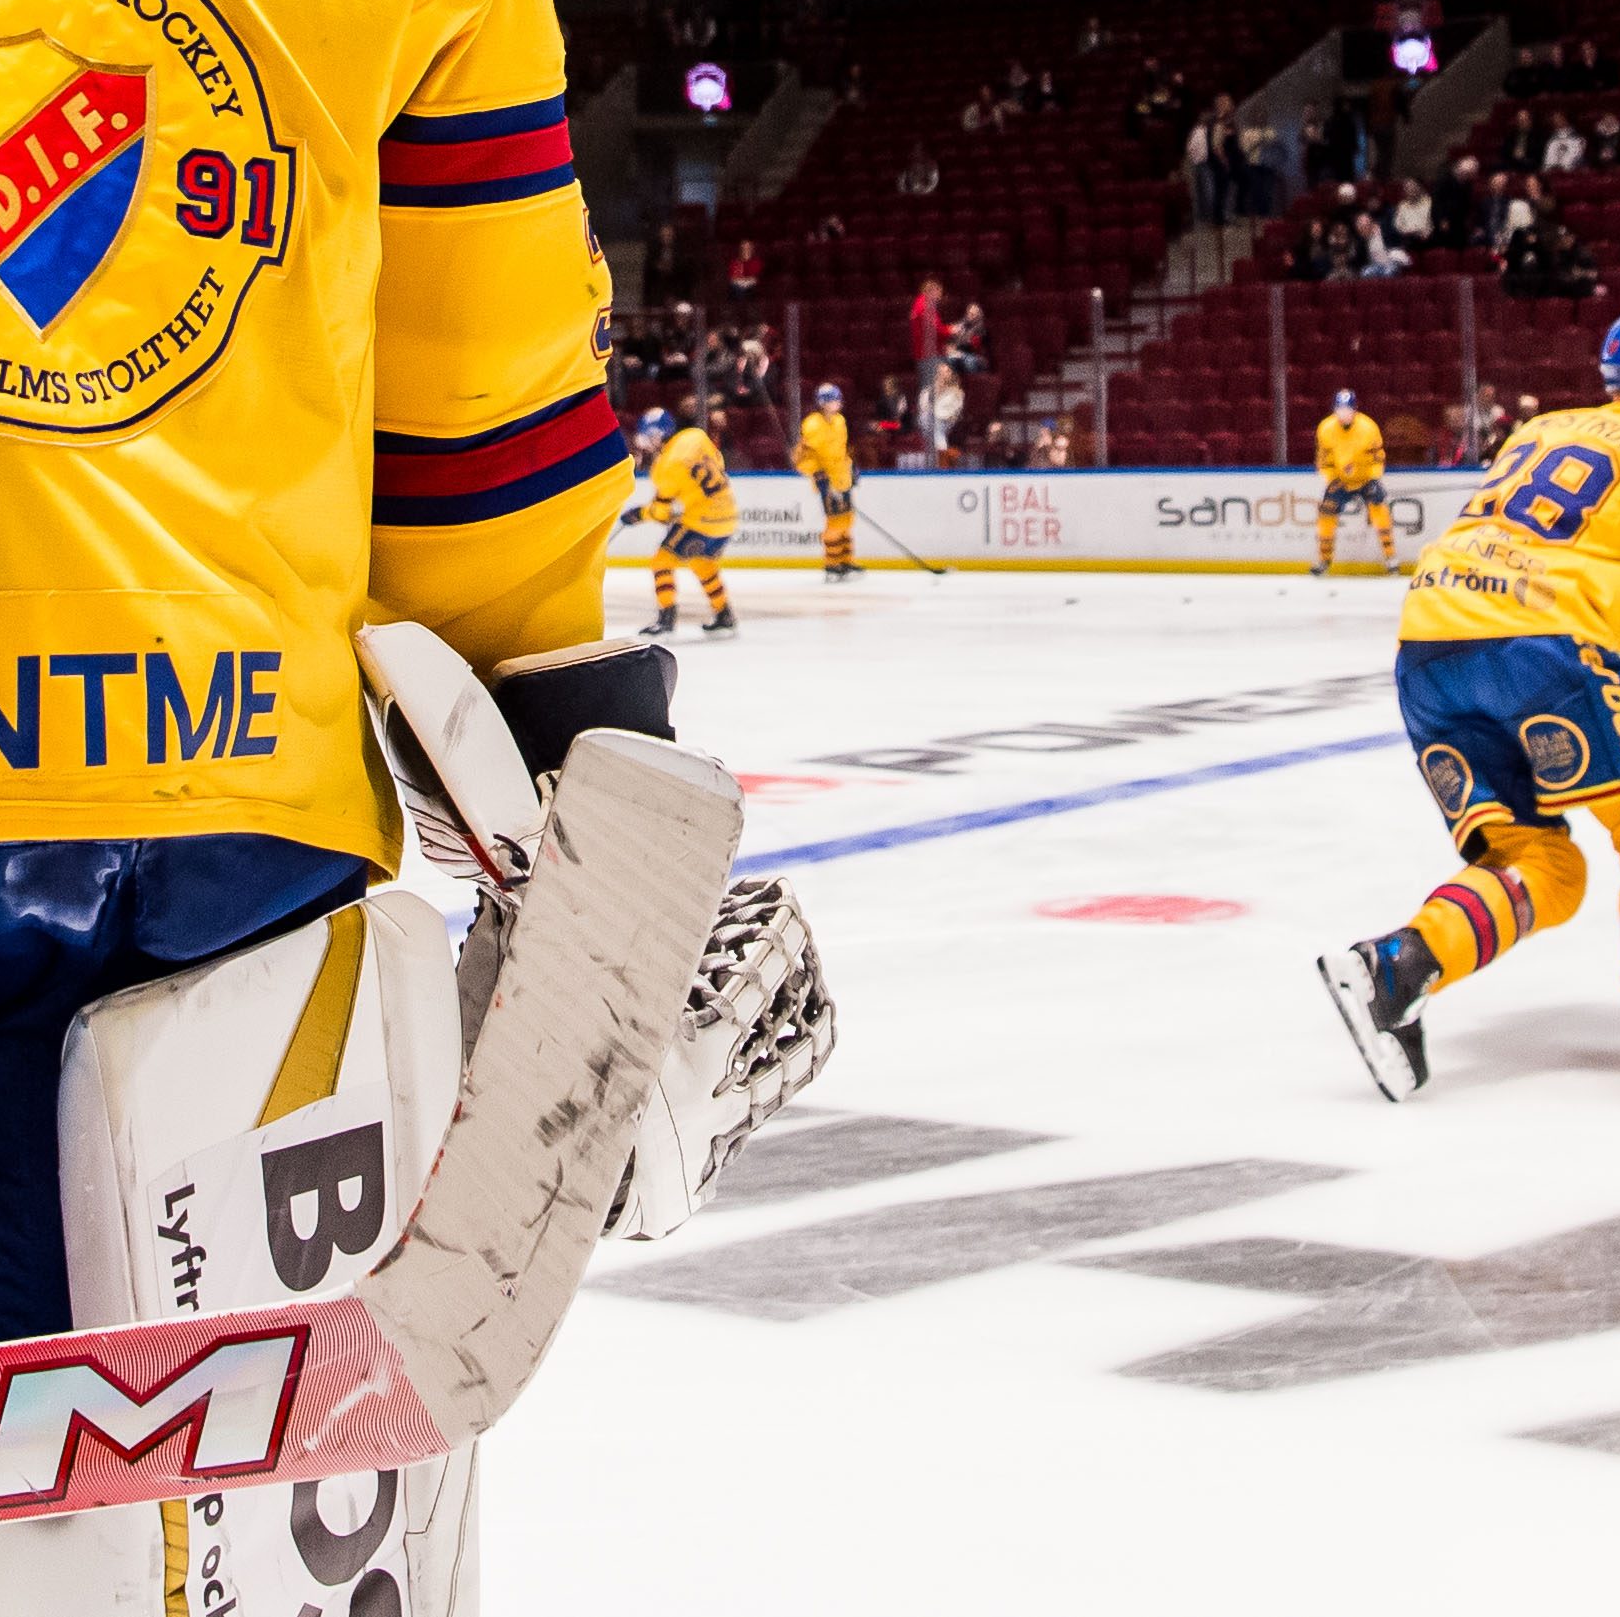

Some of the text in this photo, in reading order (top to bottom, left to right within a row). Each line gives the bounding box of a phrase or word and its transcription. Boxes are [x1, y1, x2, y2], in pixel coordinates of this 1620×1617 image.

[175, 147, 278, 248] 91
[78, 265, 226, 406] STOLTHET
[999, 483, 1059, 514] BAL
[999, 517, 1062, 547] DER
[1457, 439, 1620, 546] 28
